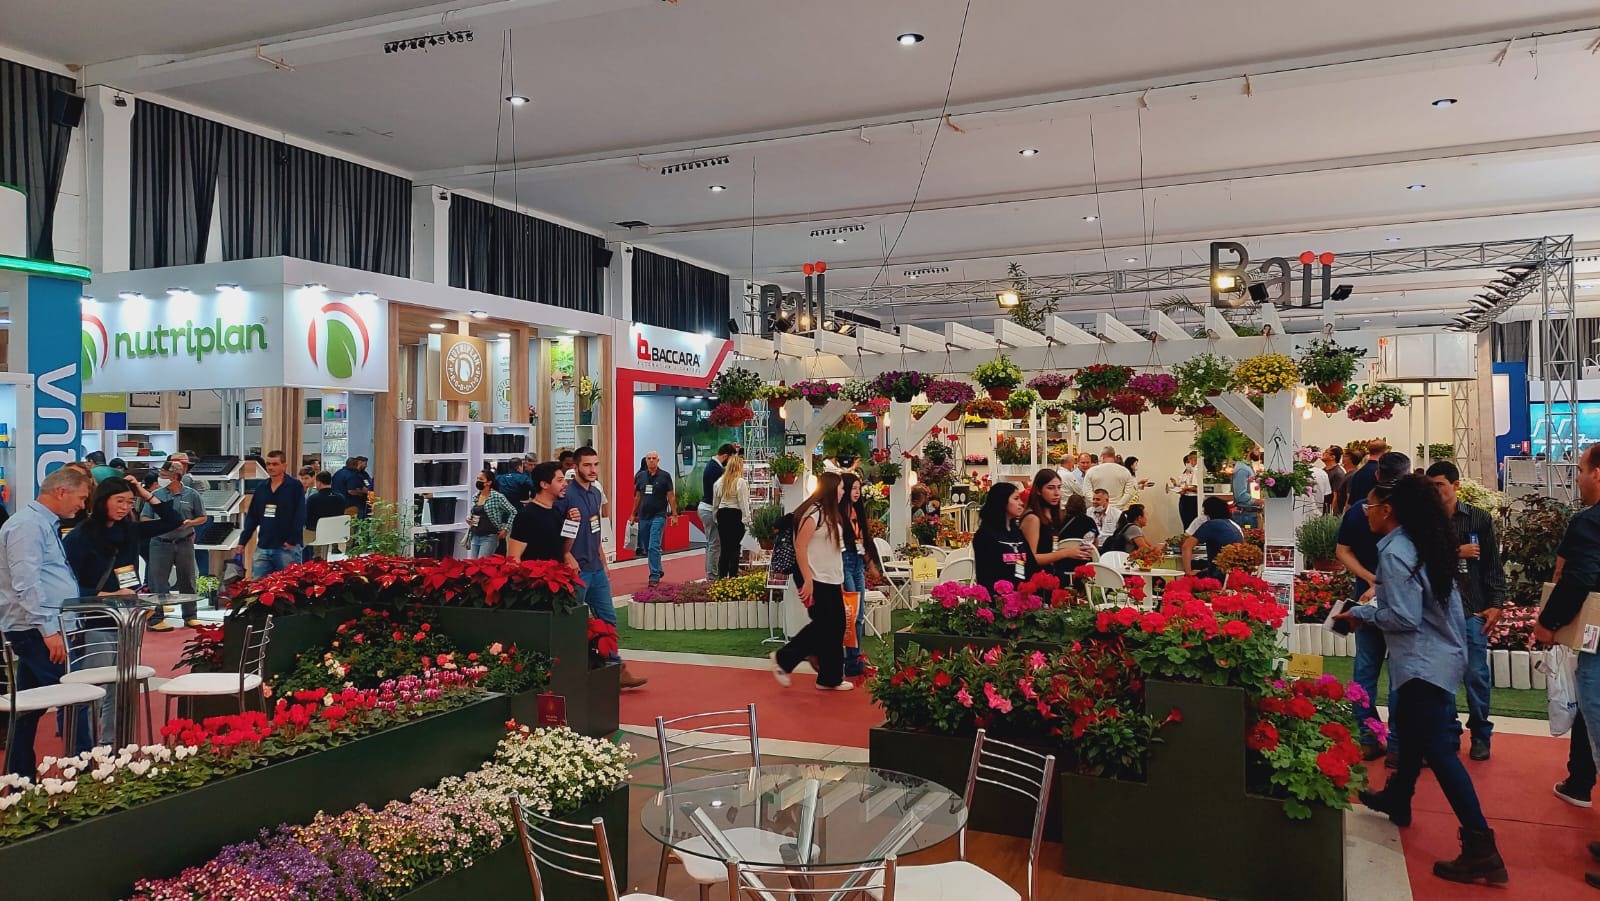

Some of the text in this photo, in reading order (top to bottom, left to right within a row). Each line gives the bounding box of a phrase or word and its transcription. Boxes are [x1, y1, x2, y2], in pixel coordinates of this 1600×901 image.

[114, 317, 269, 363] nutriplan
[651, 347, 701, 368] BACCARA
[1086, 410, 1142, 442] Ball
